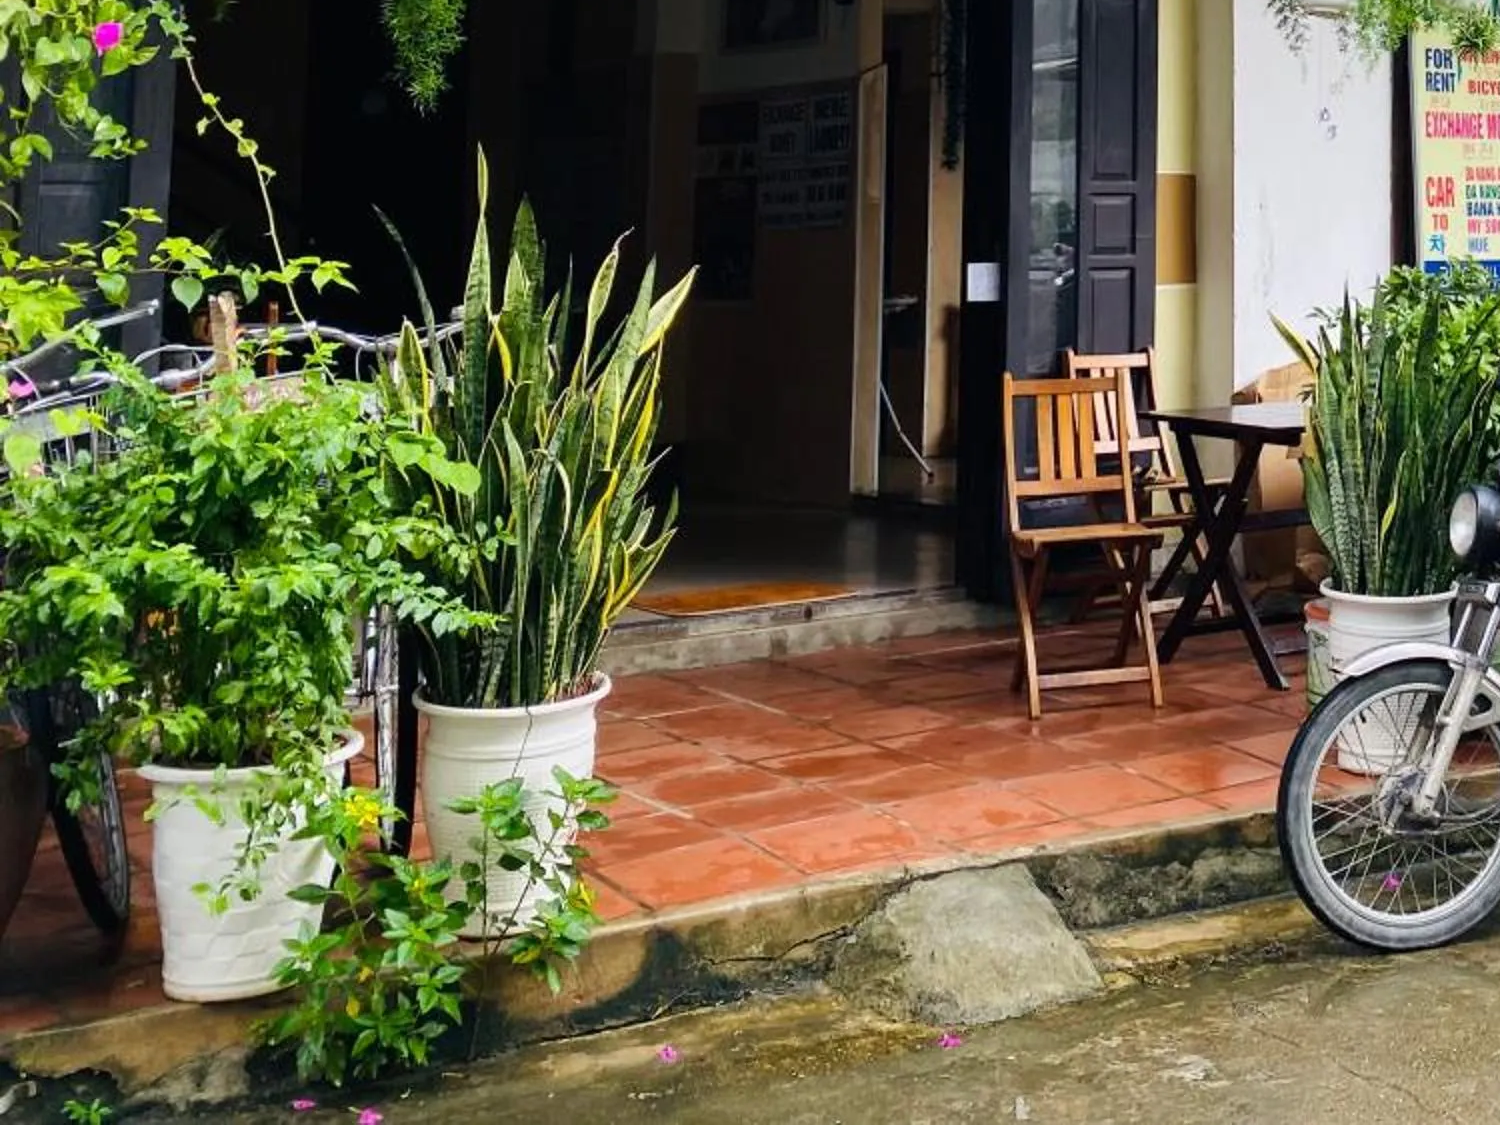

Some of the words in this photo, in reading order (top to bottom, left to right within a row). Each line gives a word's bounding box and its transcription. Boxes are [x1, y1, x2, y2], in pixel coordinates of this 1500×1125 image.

[1425, 47, 1453, 69] FOR
[1425, 72, 1456, 93] RENT
[1425, 111, 1484, 139] EXCHANGE
[1425, 175, 1455, 207] CAR
[1432, 214, 1449, 231] TO
